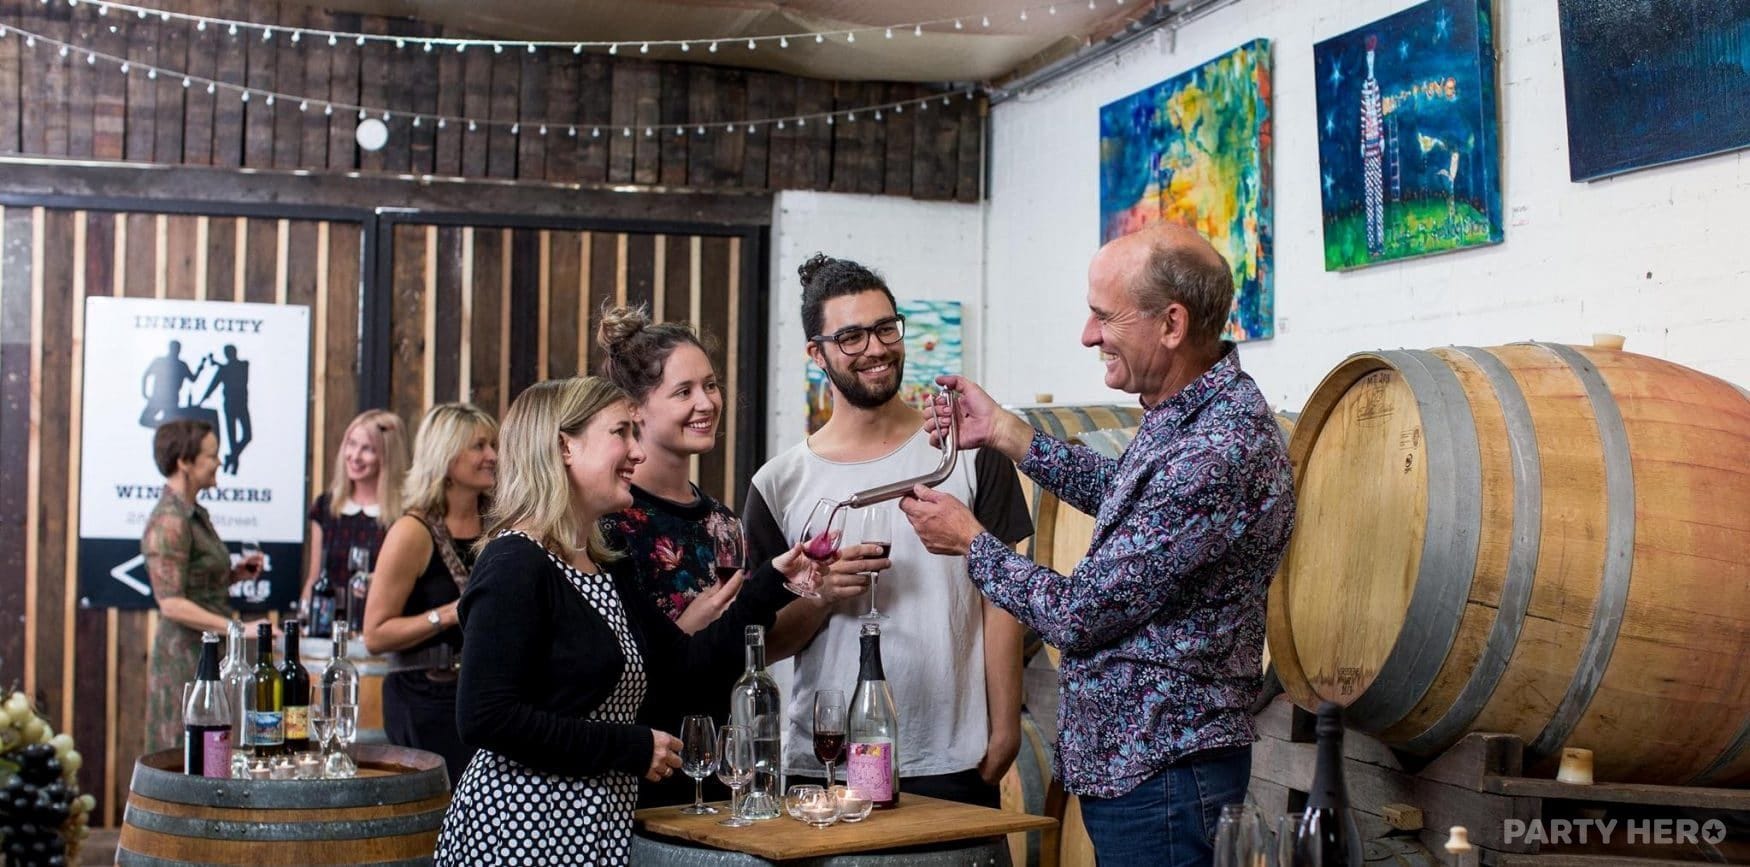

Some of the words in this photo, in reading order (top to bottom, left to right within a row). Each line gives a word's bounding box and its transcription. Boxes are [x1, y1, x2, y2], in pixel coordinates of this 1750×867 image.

[134, 314, 207, 331] INNER
[213, 317, 263, 333] CITY
[116, 485, 272, 502] WINAKERS
